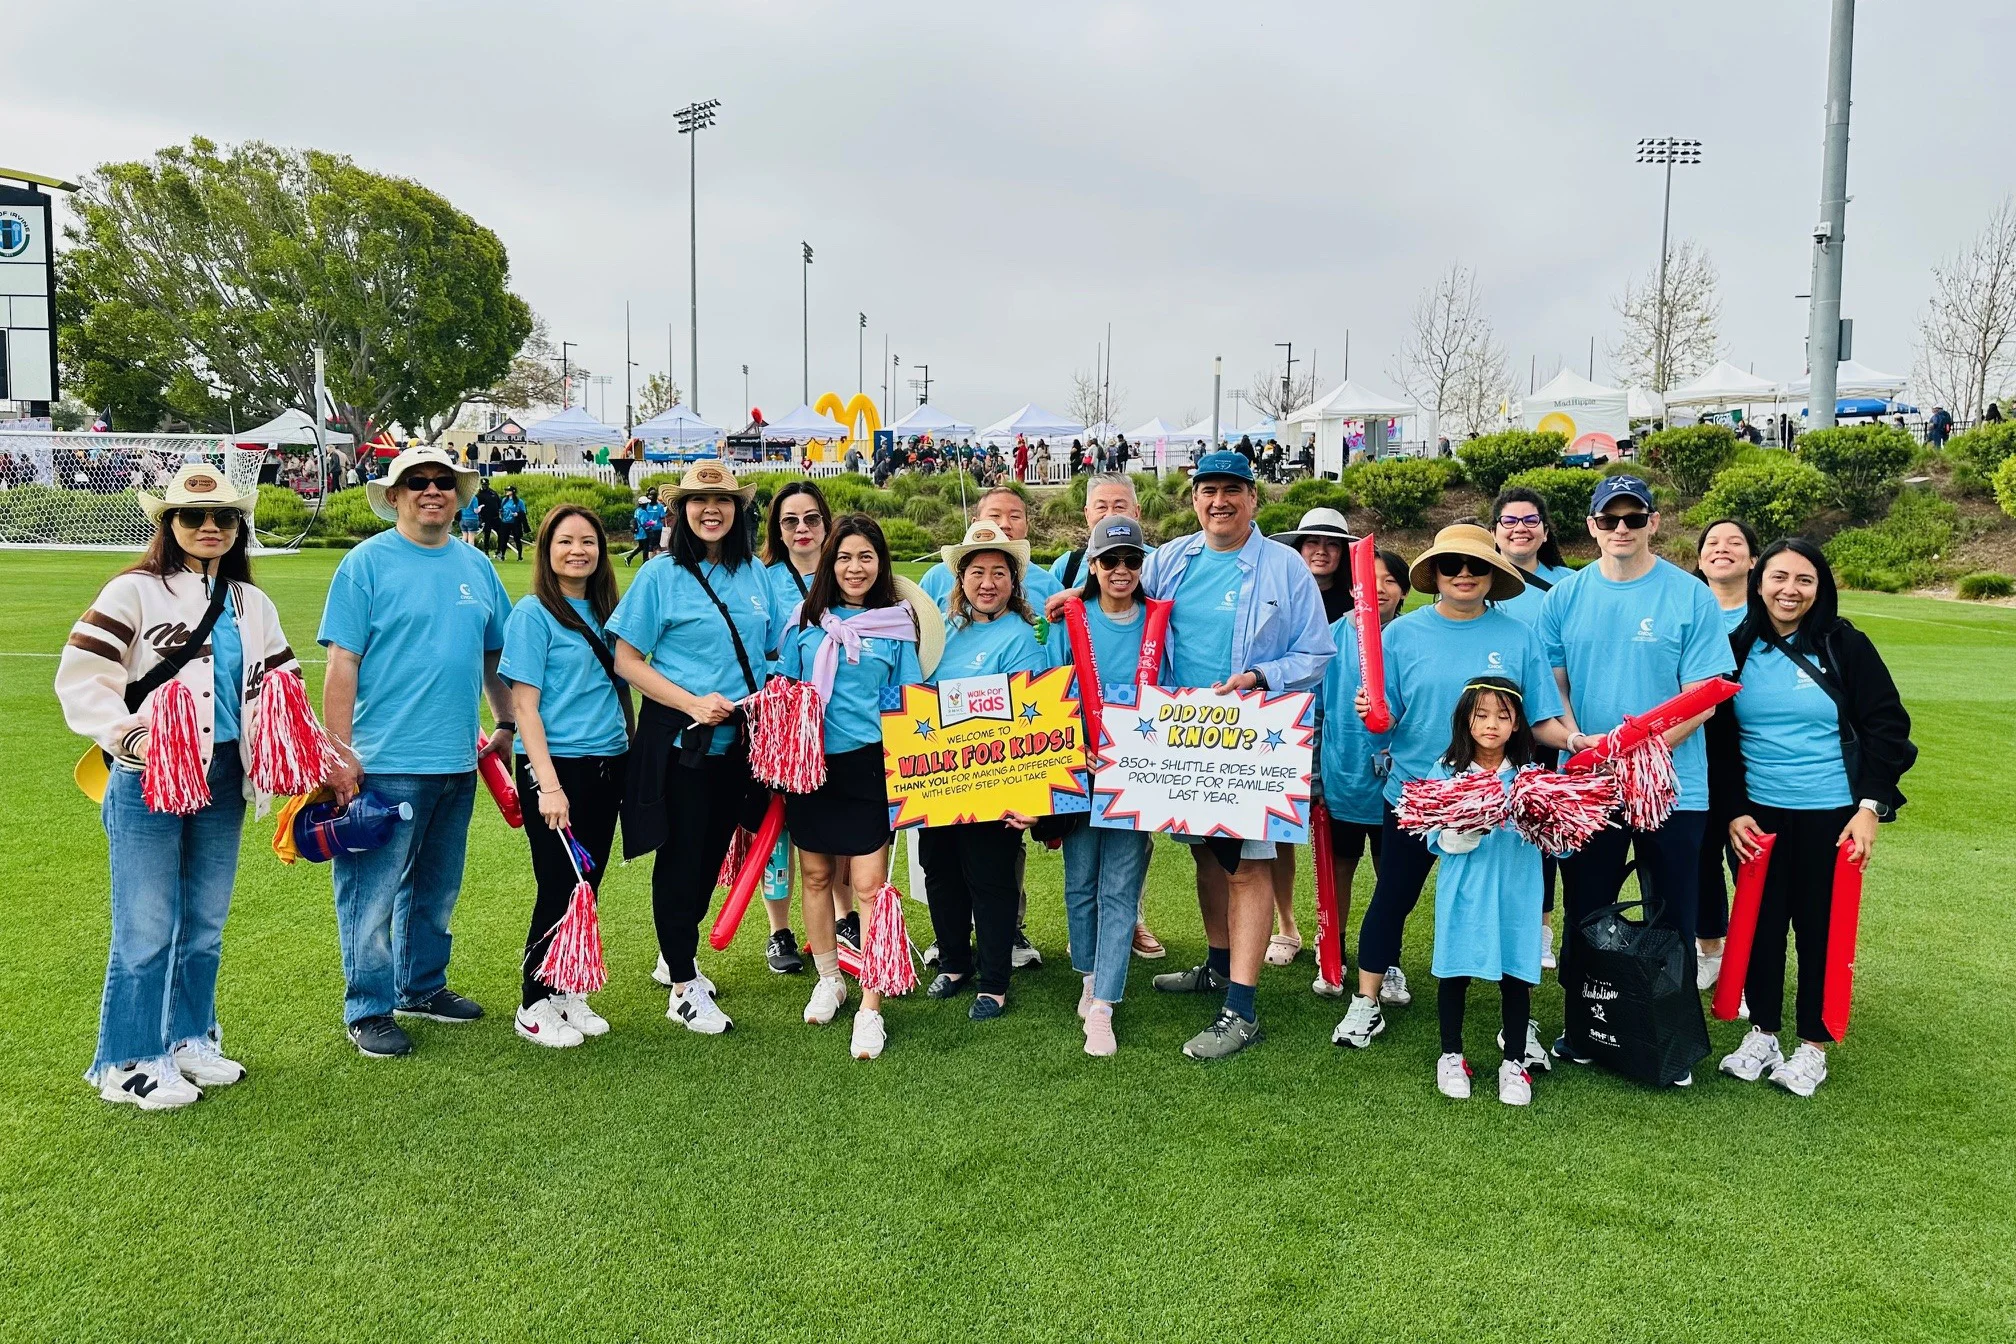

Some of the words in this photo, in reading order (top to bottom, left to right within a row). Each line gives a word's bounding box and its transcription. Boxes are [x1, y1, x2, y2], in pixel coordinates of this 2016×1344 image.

[143, 621, 192, 647] Ne
[1143, 639, 1158, 656] 35
[1159, 704, 1196, 723] DID
[1199, 706, 1240, 725] YOU
[947, 732, 994, 744] WELCOME
[998, 726, 1010, 735] TO
[1168, 725, 1258, 750] KNOW?
[898, 750, 958, 778] WALK
[962, 740, 1005, 769] FOR
[1010, 726, 1075, 760] KIDS!
[894, 780, 926, 793] THANK
[929, 777, 948, 786] YOU
[951, 774, 970, 783] FOR
[972, 767, 1007, 779] MAKING
[1018, 755, 1073, 771] DIFFERENCE
[1119, 757, 1156, 768] 850+
[1161, 759, 1214, 773] SHUTTLE
[1220, 763, 1256, 776] RIDES
[1260, 767, 1297, 779] WERE
[922, 789, 942, 799] WITH
[945, 784, 972, 796] EVERY
[976, 779, 999, 790] STEP
[1002, 776, 1021, 785] YOU
[1024, 771, 1047, 781] TAKE
[1128, 771, 1192, 786] PROVIDED
[1196, 776, 1223, 788] FOR
[1228, 779, 1284, 792] FAMILIES
[1169, 789, 1198, 801] LAST
[1203, 791, 1239, 805] YEAR.
